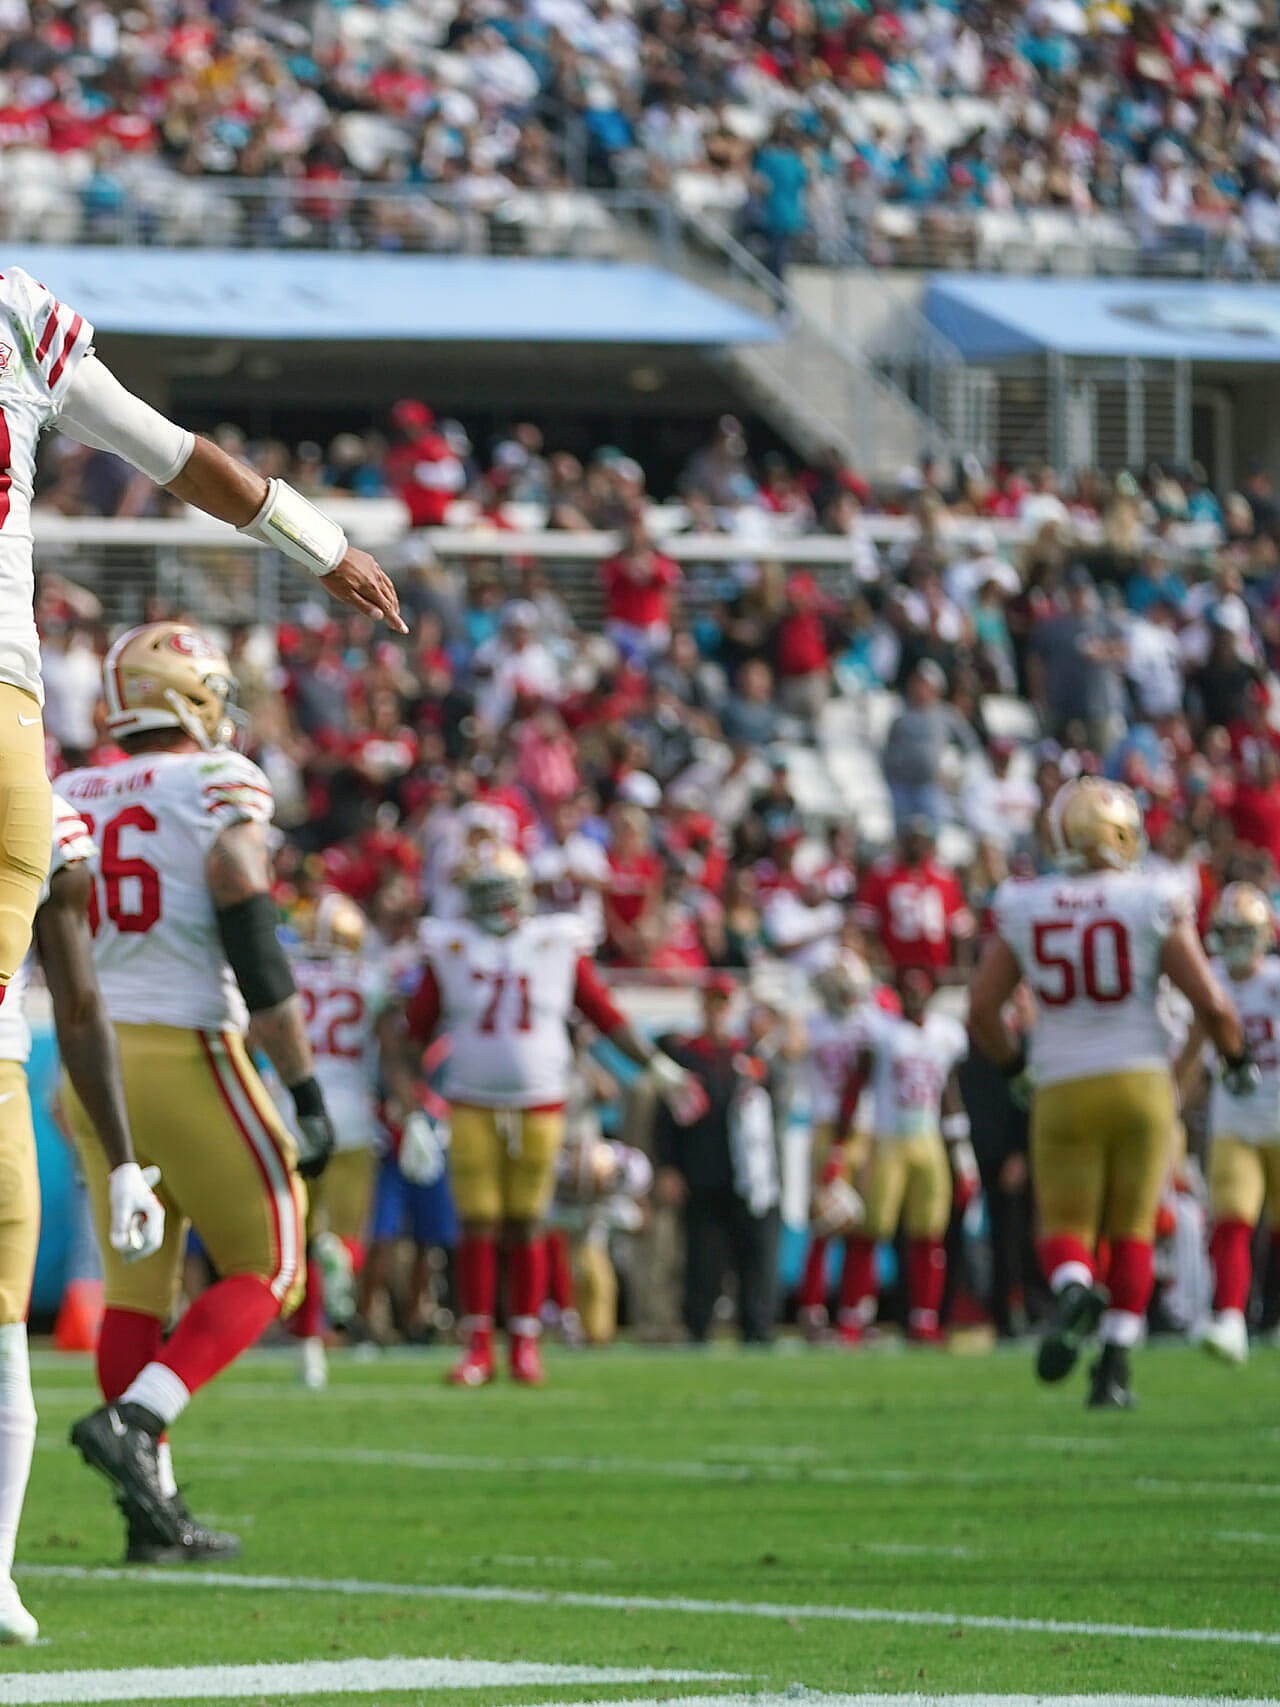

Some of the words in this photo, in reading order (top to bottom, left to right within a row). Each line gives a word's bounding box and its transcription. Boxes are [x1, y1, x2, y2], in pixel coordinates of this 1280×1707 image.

[80, 804, 161, 940] 6
[472, 971, 532, 1034] 71
[1033, 918, 1132, 1006] 50
